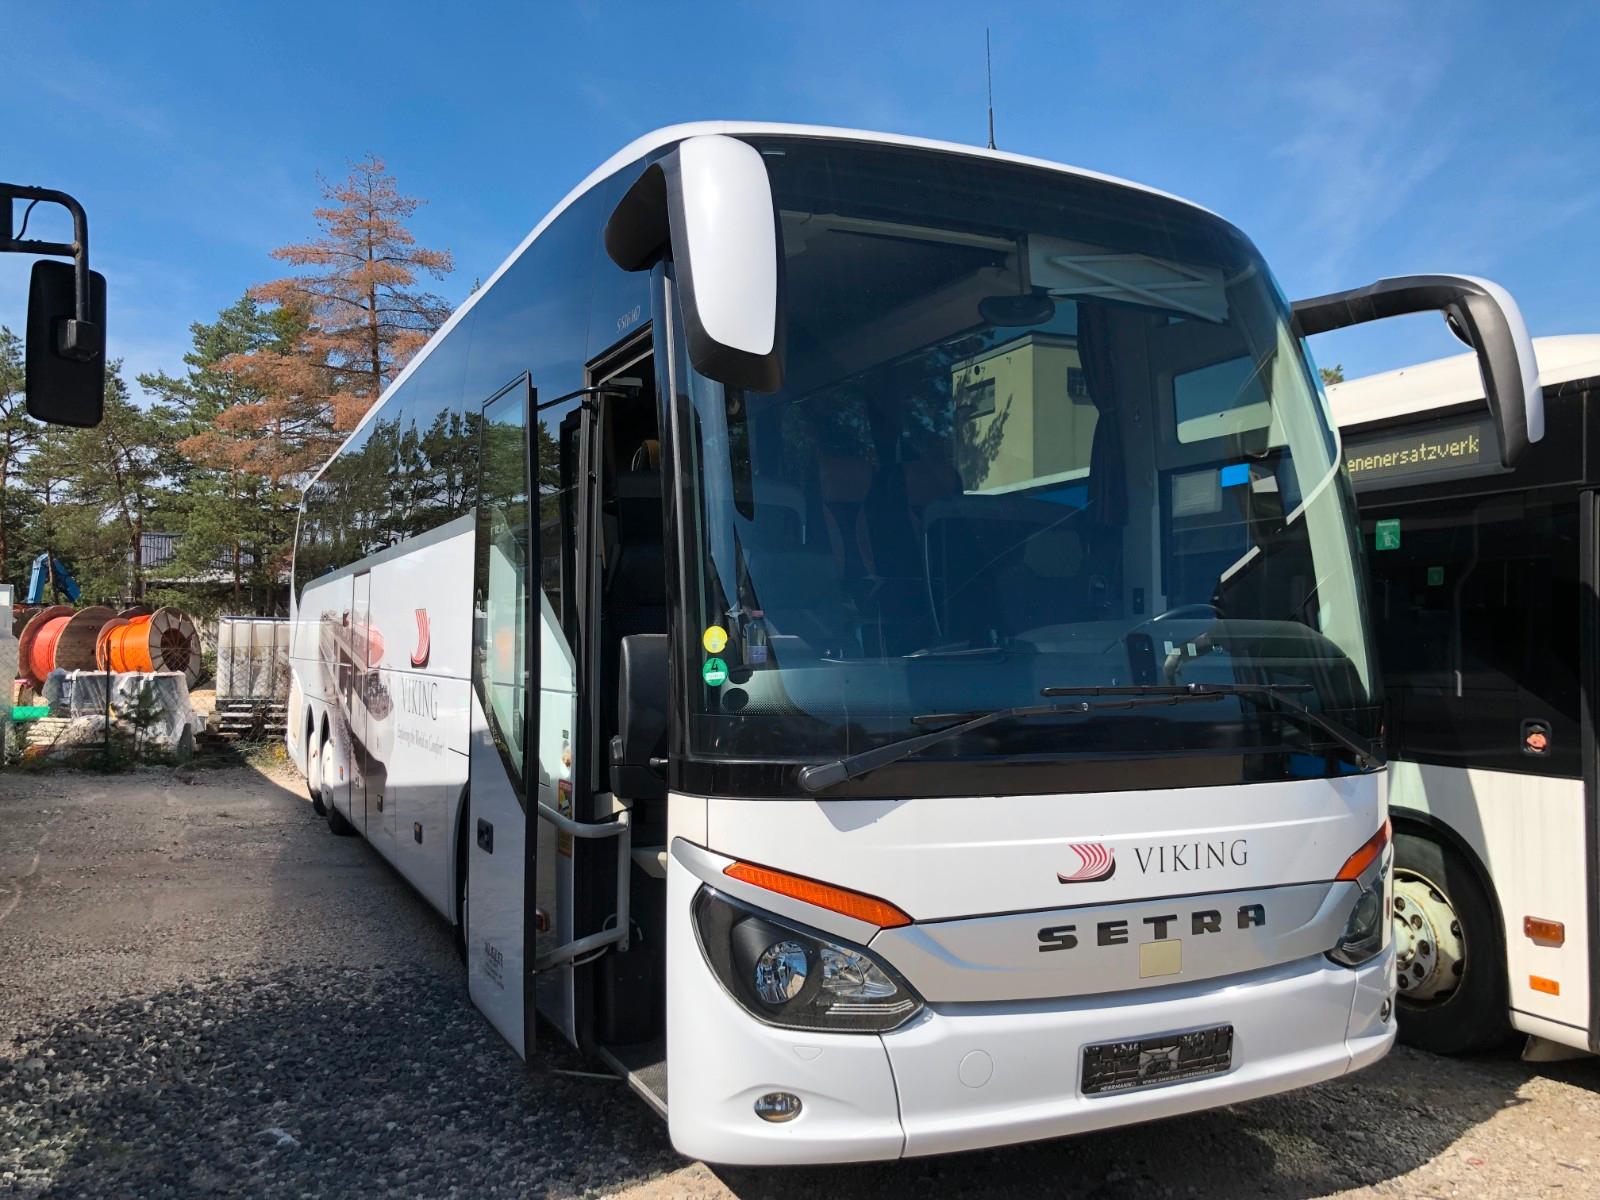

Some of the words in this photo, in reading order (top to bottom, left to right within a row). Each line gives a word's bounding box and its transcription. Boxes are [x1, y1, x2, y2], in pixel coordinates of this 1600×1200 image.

[711, 659, 719, 671] 4
[401, 678, 438, 721] VIKING
[1134, 839, 1248, 875] VIKING
[1037, 903, 1266, 952] SETRA
